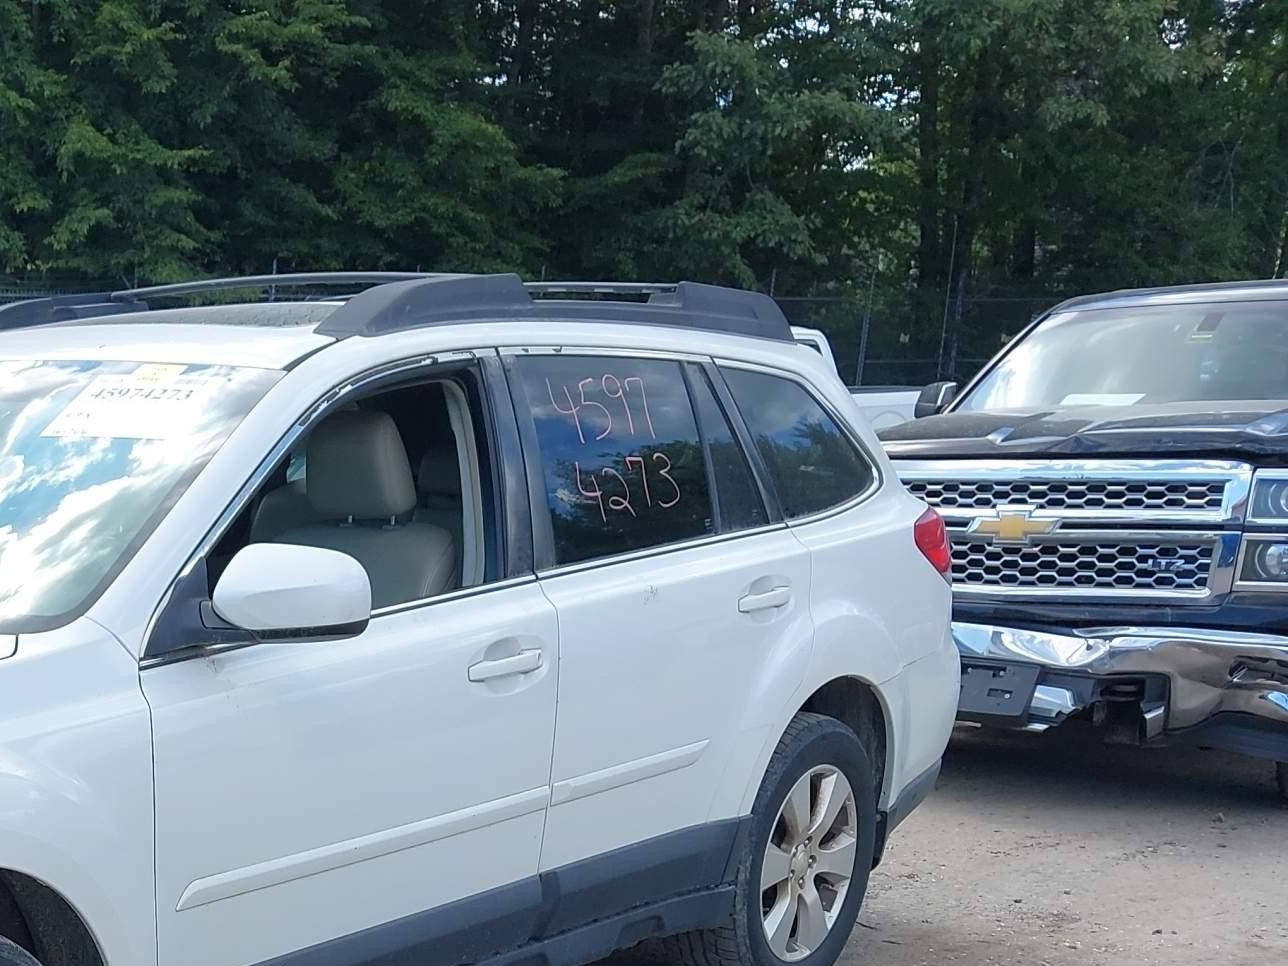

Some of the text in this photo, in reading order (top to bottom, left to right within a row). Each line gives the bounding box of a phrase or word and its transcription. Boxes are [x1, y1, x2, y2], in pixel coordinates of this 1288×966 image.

[91, 387, 195, 401] 45974273
[545, 374, 656, 444] 4597
[575, 452, 681, 523] 4273
[1148, 558, 1185, 571] LTZ
